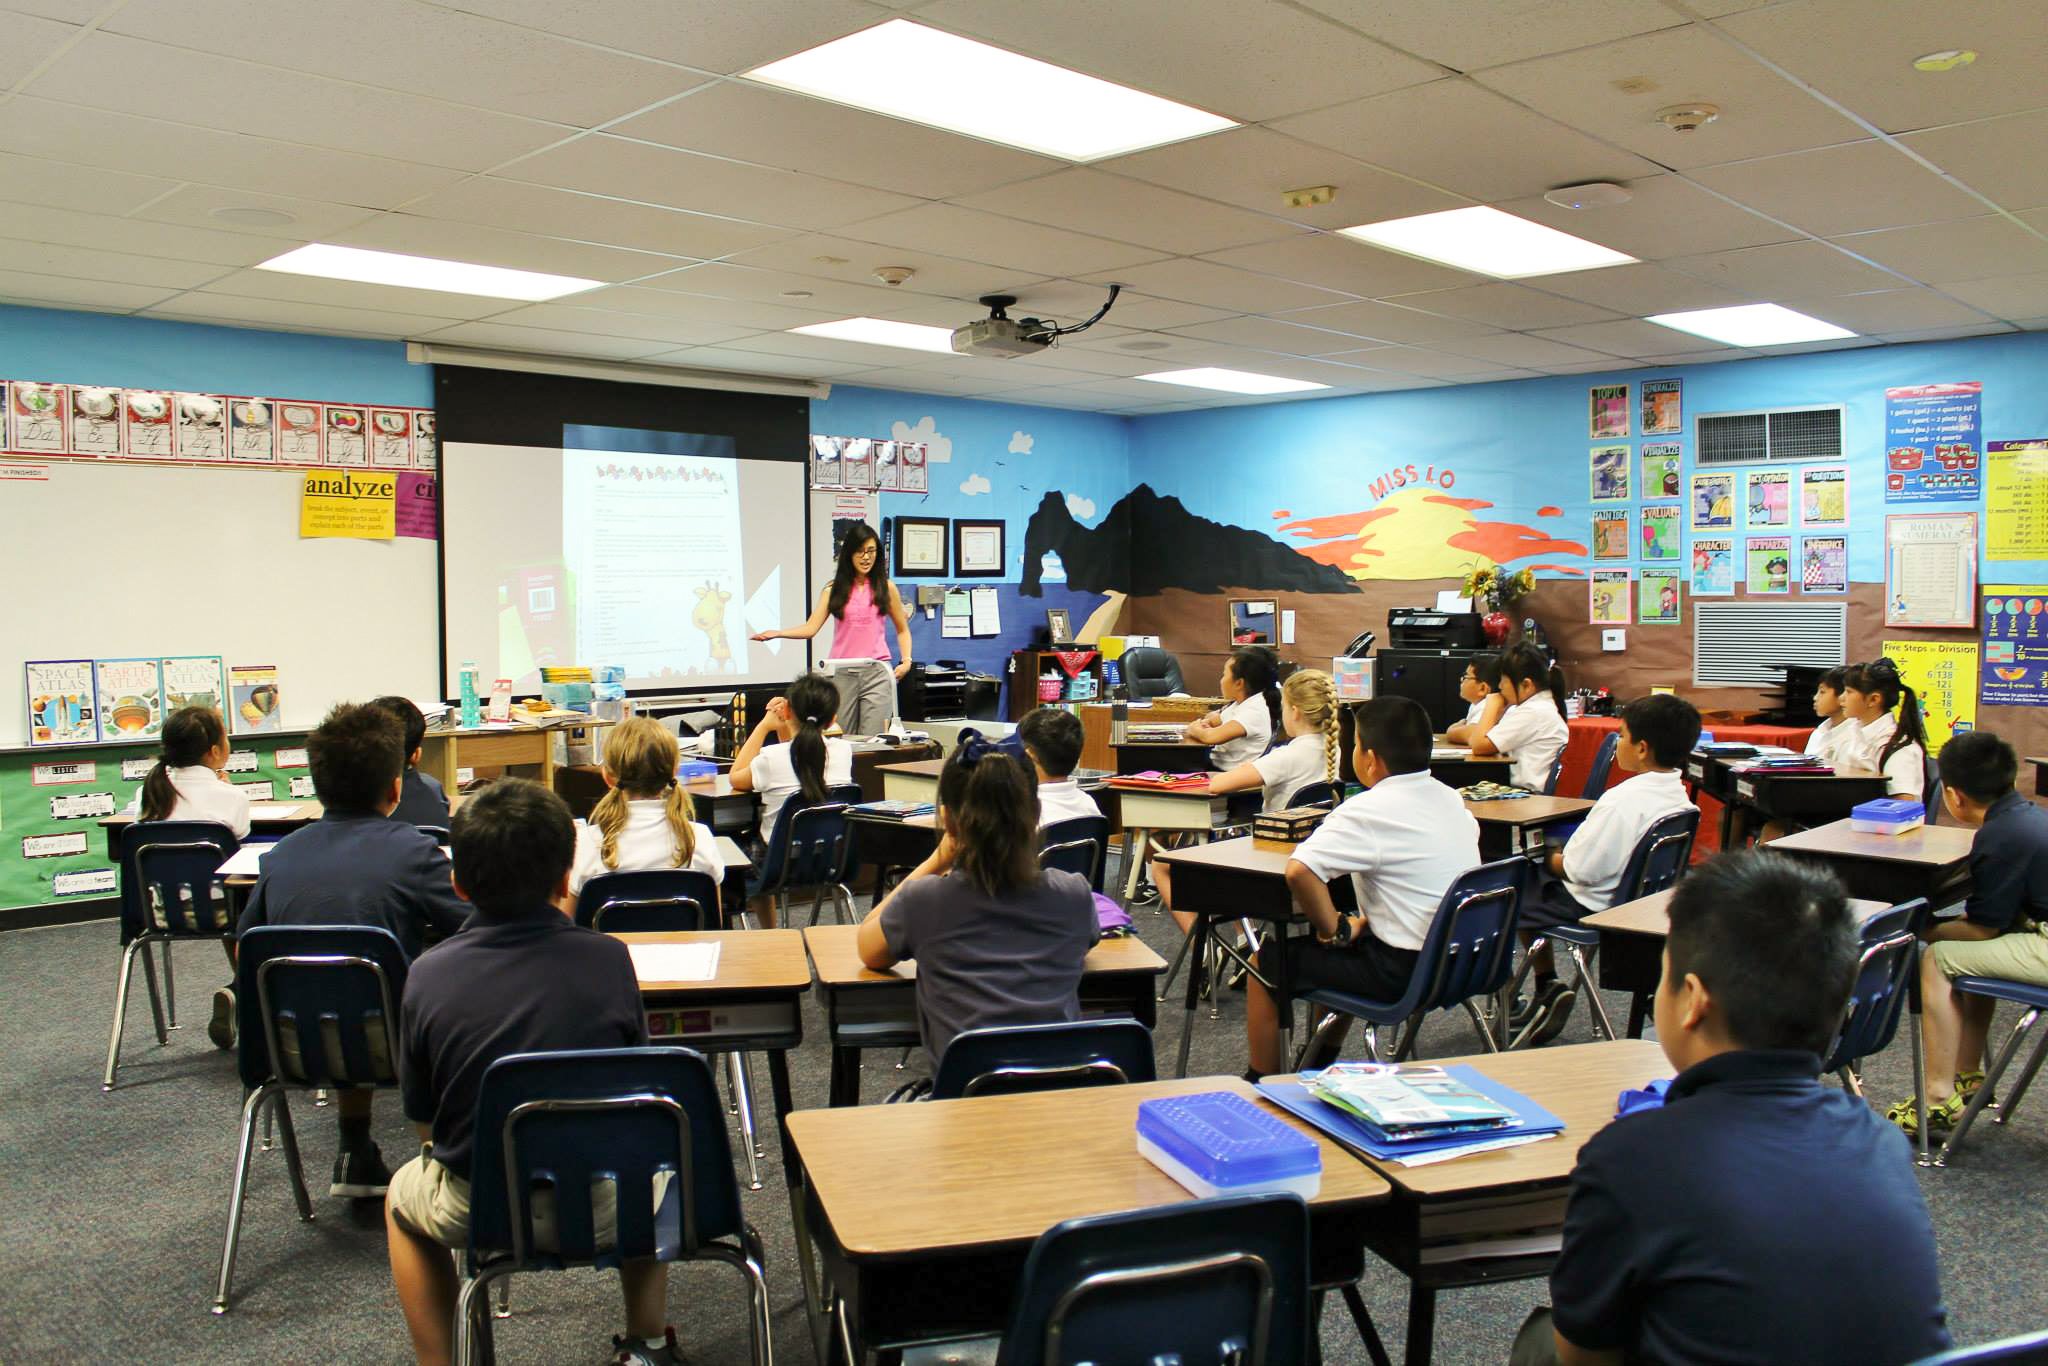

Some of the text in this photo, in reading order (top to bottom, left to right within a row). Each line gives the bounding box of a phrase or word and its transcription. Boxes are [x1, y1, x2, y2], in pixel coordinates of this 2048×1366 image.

[1597, 387, 1623, 400] TOPIC
[305, 475, 394, 500] analyze
[1368, 464, 1455, 501] MISS LO
[1884, 643, 1901, 651] Five
[1904, 644, 1928, 653] Steps
[1938, 644, 1976, 654] Division
[34, 668, 87, 681] SPACE
[103, 667, 152, 679] EARTH
[171, 673, 216, 685] ATLAS
[36, 680, 87, 692] ATLAS
[107, 678, 152, 690] ATLAS
